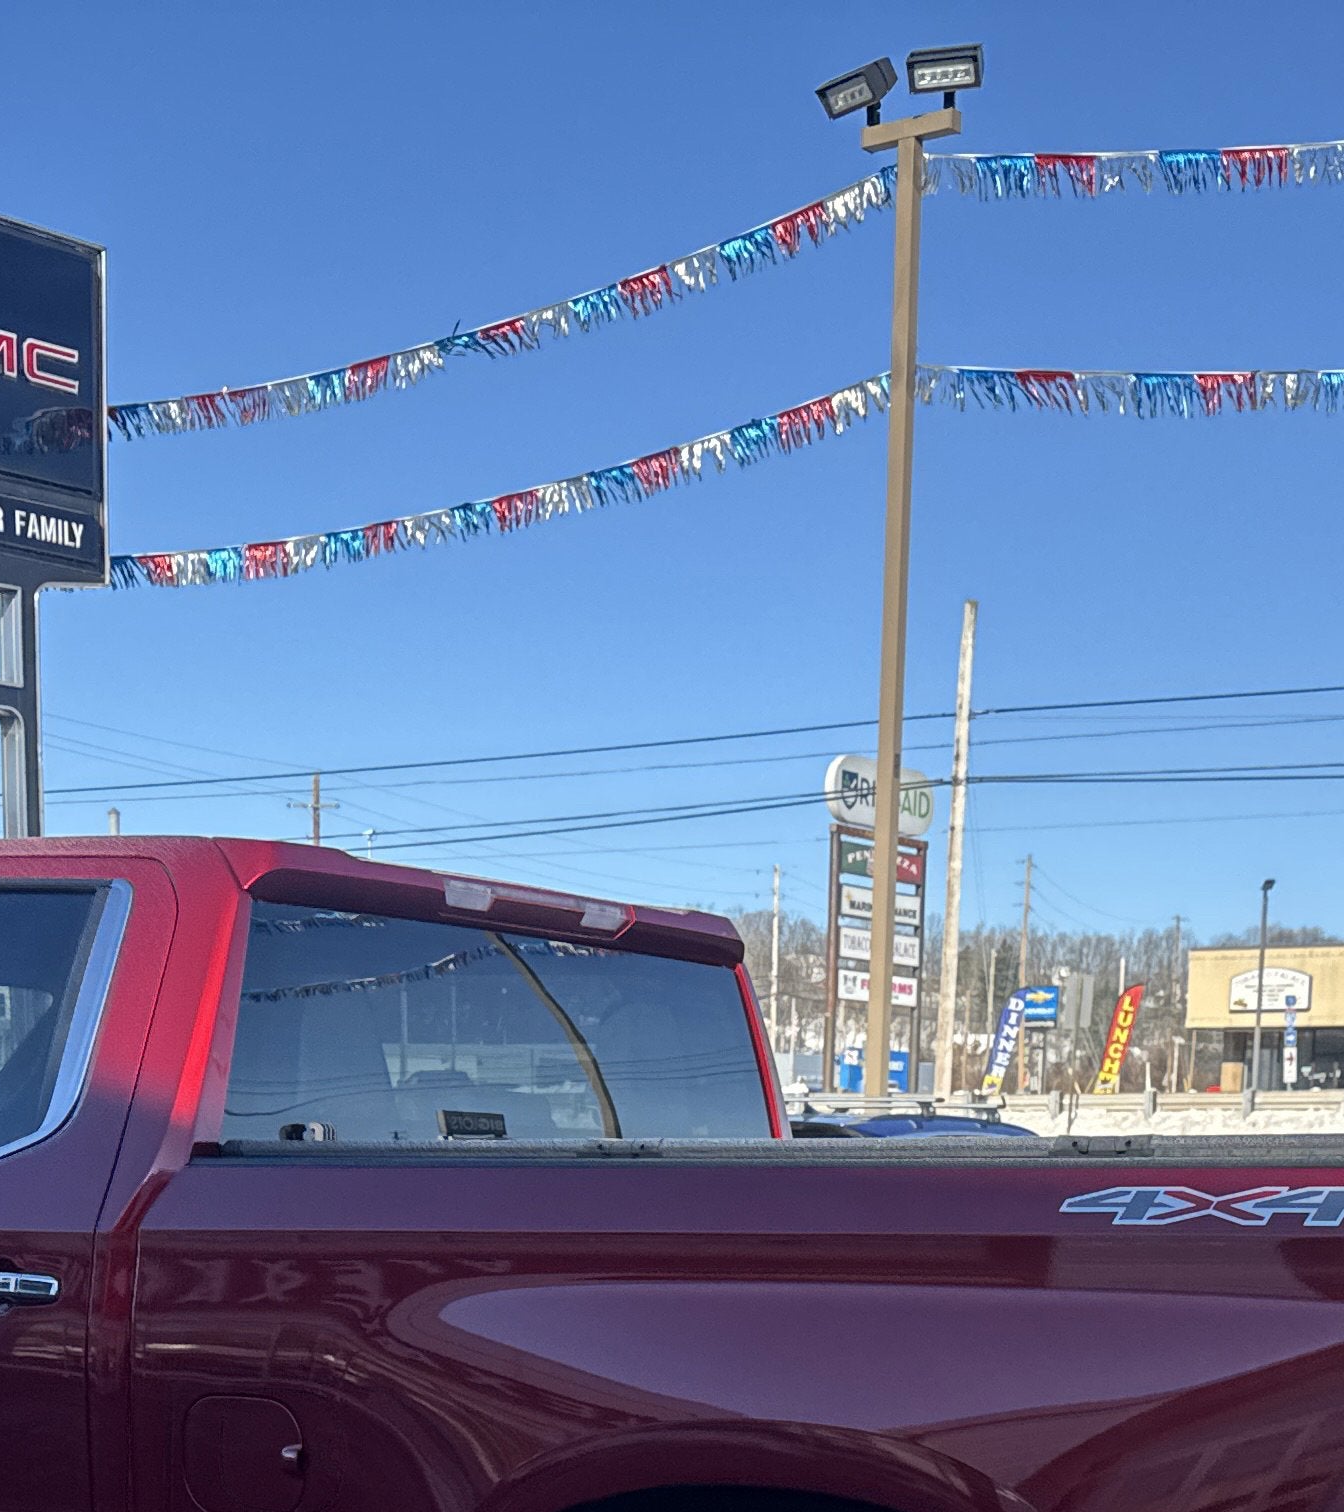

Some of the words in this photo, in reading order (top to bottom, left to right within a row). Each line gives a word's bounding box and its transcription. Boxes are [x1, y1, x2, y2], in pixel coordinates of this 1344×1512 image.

[14, 509, 85, 549] FAMILY
[860, 777, 877, 808] RI
[900, 787, 930, 819] AID
[847, 849, 872, 864] PEN
[896, 855, 918, 876] ZZA
[844, 934, 871, 953] TOBACC
[990, 997, 1025, 1077] DINNER
[1102, 995, 1135, 1073] LUNCH
